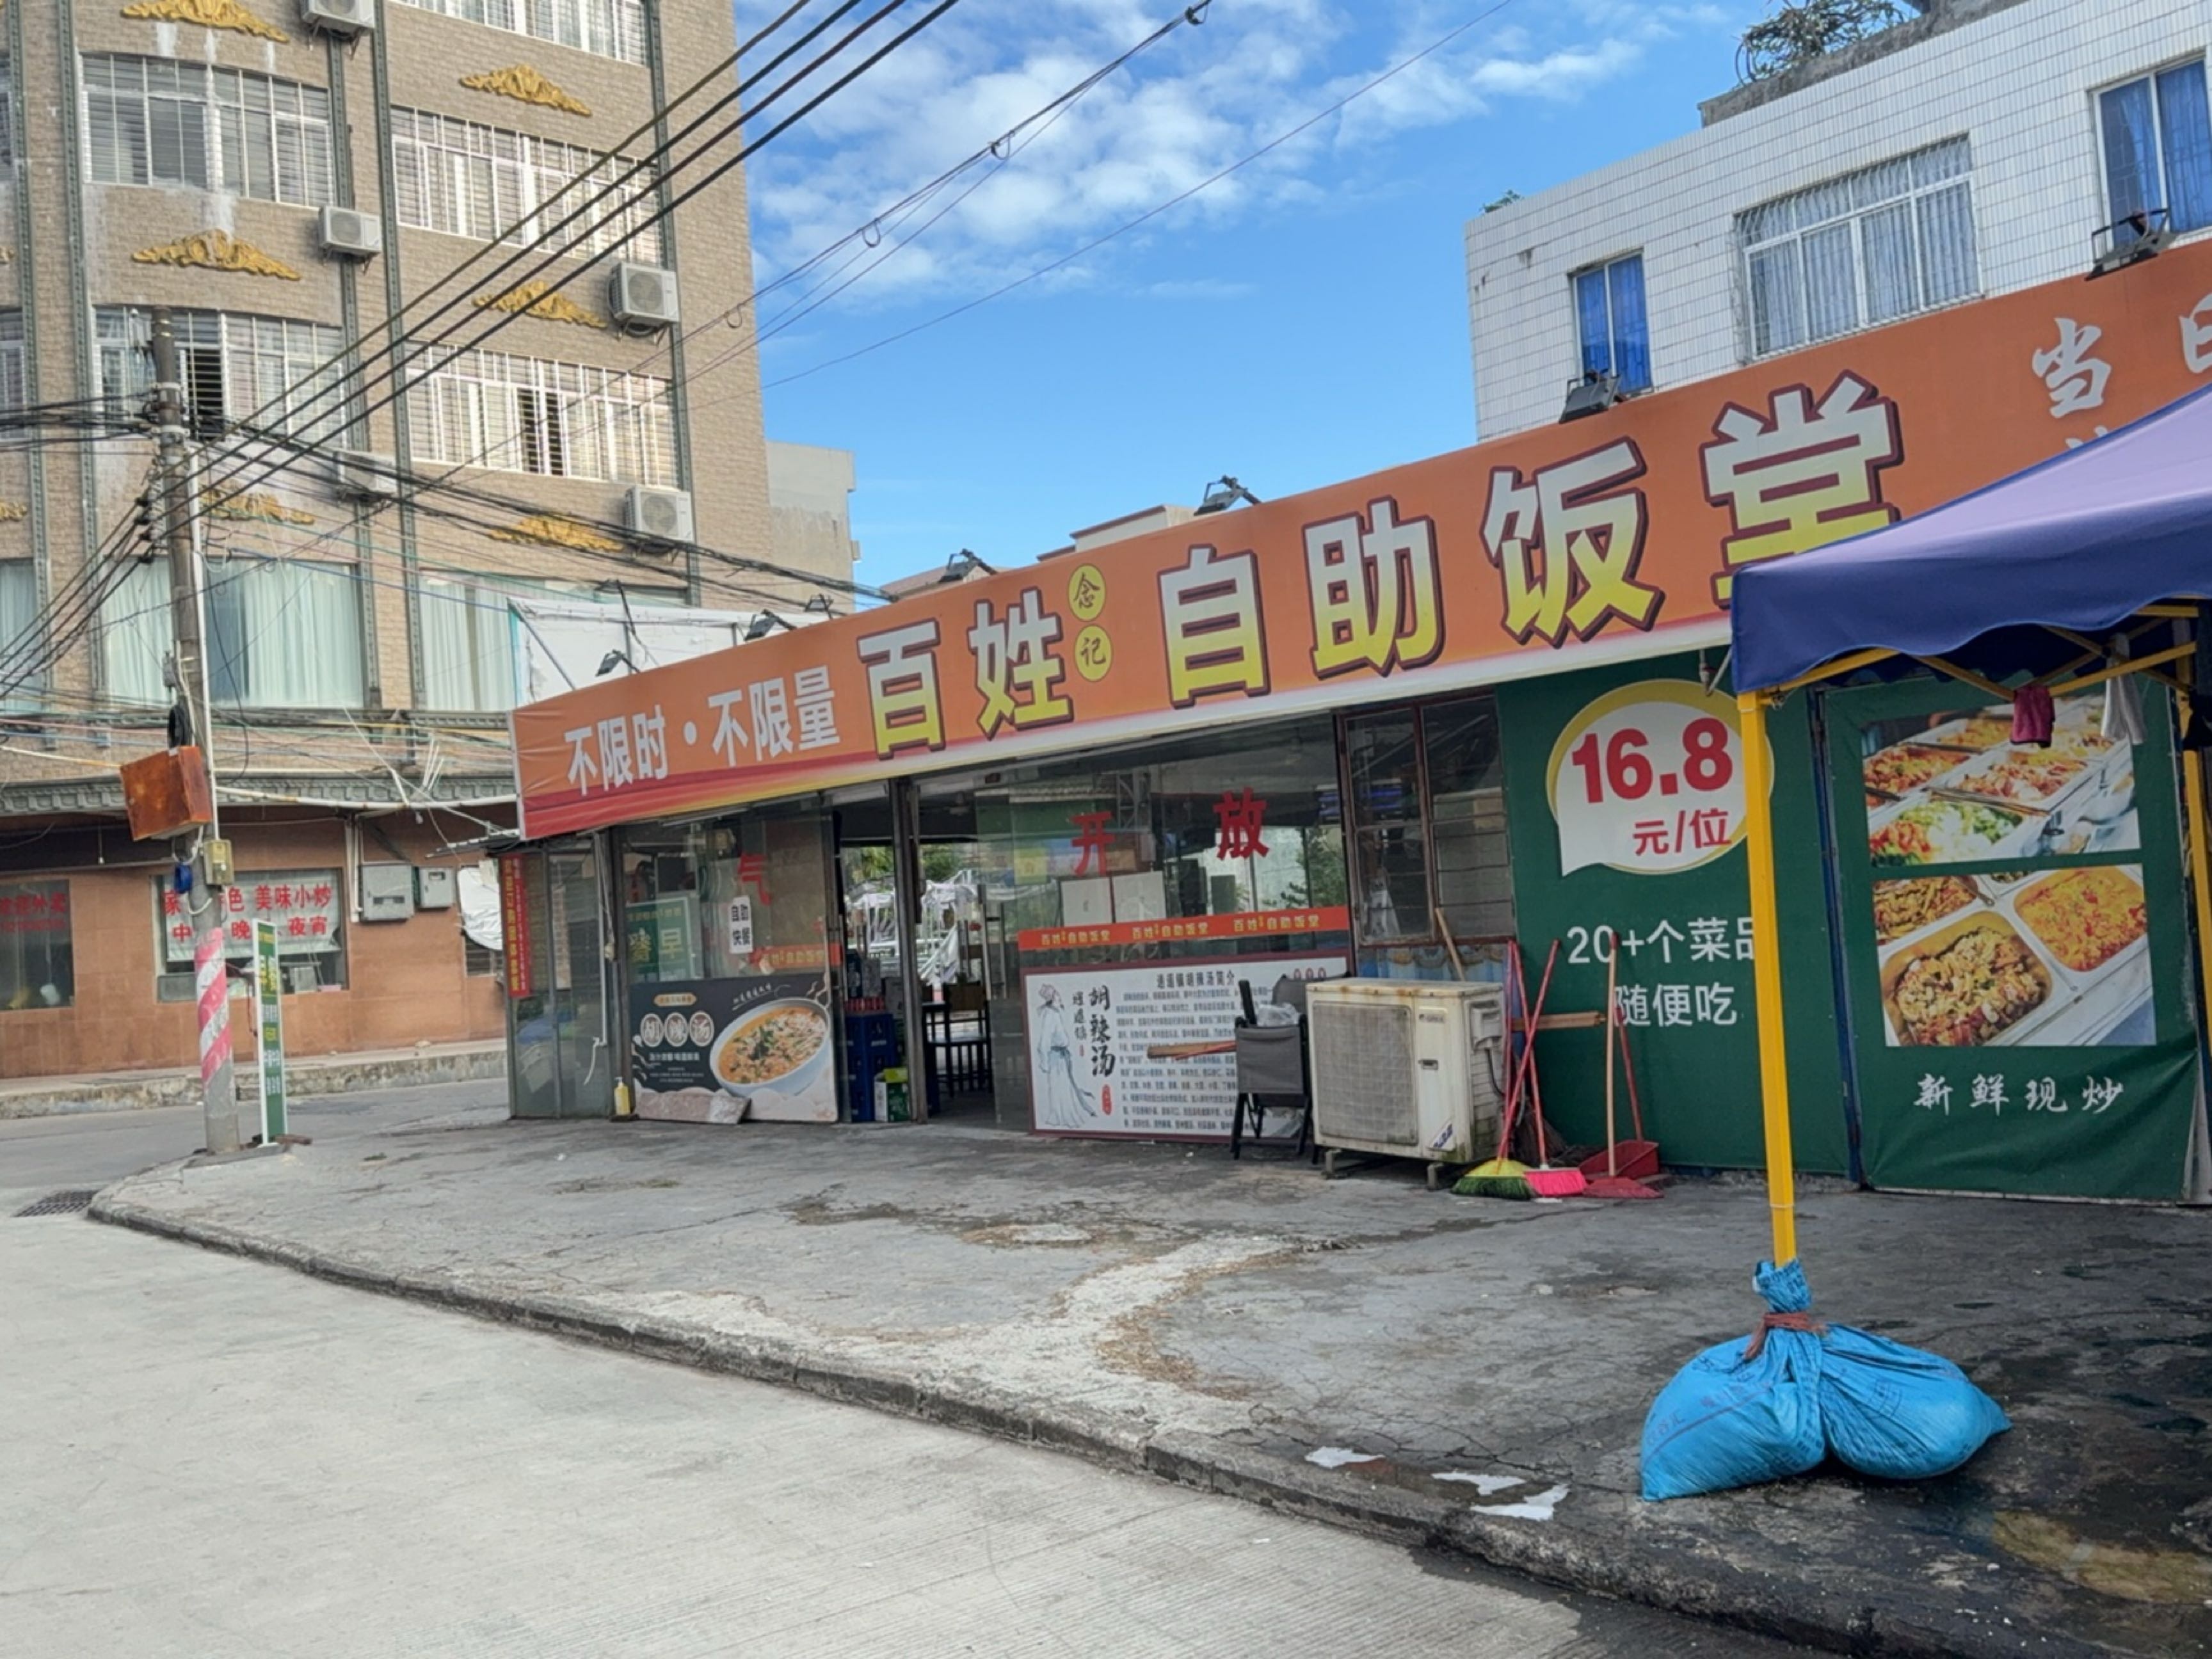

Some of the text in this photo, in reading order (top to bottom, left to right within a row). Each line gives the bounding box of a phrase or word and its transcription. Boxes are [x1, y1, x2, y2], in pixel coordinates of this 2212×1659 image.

[857, 586, 1075, 761] 百姓
[1157, 369, 1903, 709] 自助饭堂
[1572, 717, 1733, 804] 16.8
[1633, 808, 1732, 856] 元/位
[255, 882, 332, 911] 美味小炒
[1567, 917, 1755, 964] 20+个菜品
[1614, 981, 1738, 1027] 随便吃
[1089, 984, 1116, 1077] 胡辣汤
[1913, 1073, 2124, 1116] 新鲜现炒
